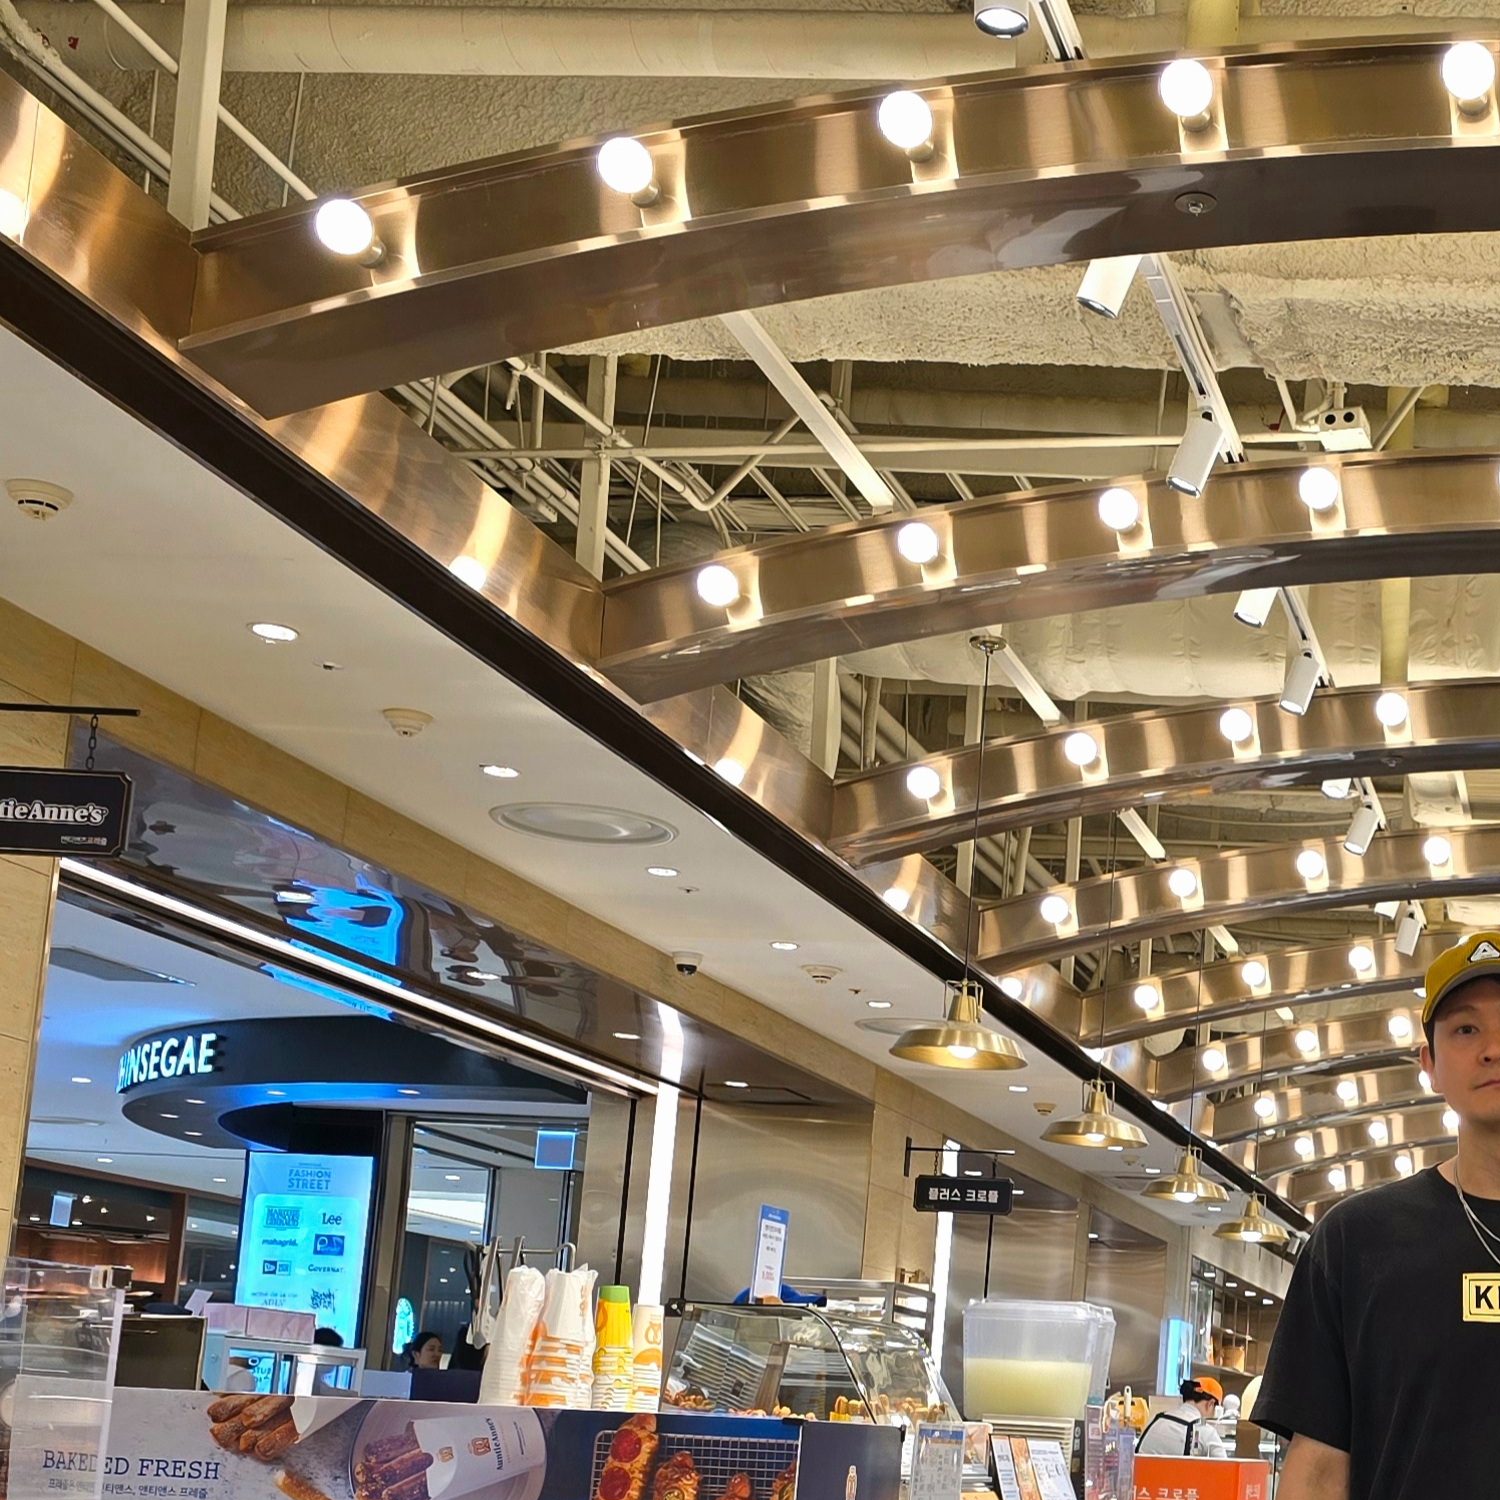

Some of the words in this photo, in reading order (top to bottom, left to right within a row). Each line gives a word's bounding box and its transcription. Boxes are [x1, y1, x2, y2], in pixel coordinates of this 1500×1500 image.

[115, 1033, 217, 1093] HINSEGAE
[289, 1169, 331, 1179] FASHION
[287, 1178, 331, 1190] STREET
[322, 1213, 342, 1225] Lee
[137, 1459, 220, 1480] FRESH
